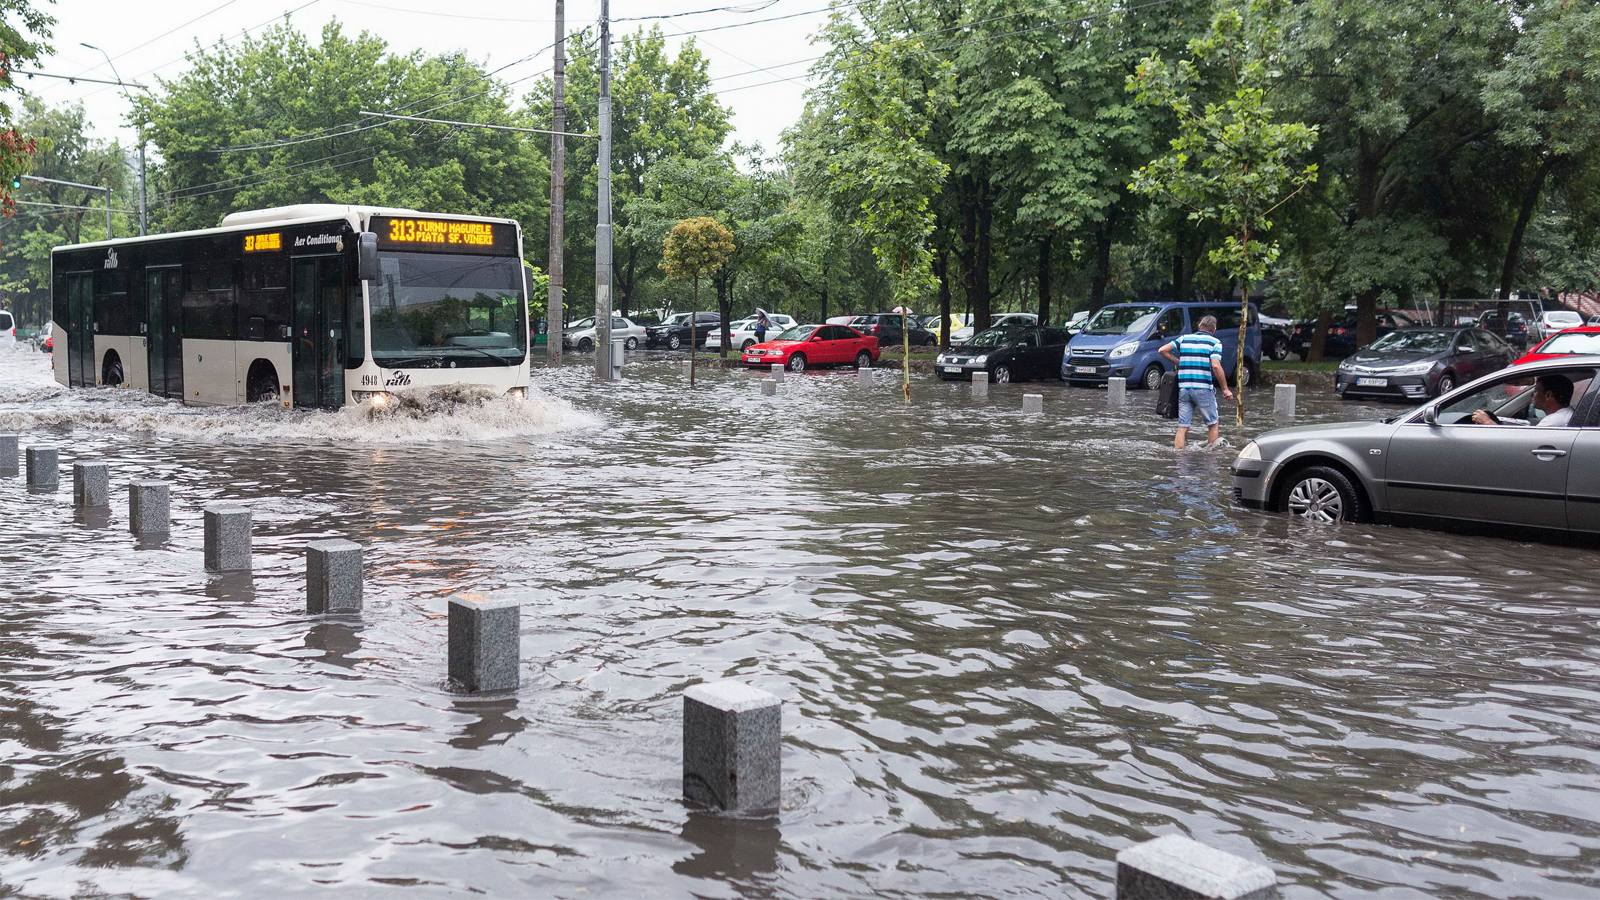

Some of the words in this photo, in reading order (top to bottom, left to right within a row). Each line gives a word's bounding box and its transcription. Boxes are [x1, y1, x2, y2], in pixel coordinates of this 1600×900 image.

[390, 219, 415, 241] 313
[417, 221, 447, 233] TURNU
[448, 223, 492, 235] MAGURELE
[294, 236, 306, 247] Aer
[416, 231, 445, 242] PIATA
[448, 233, 462, 244] SF.
[463, 234, 493, 245] VINERI
[360, 374, 378, 386] 4948
